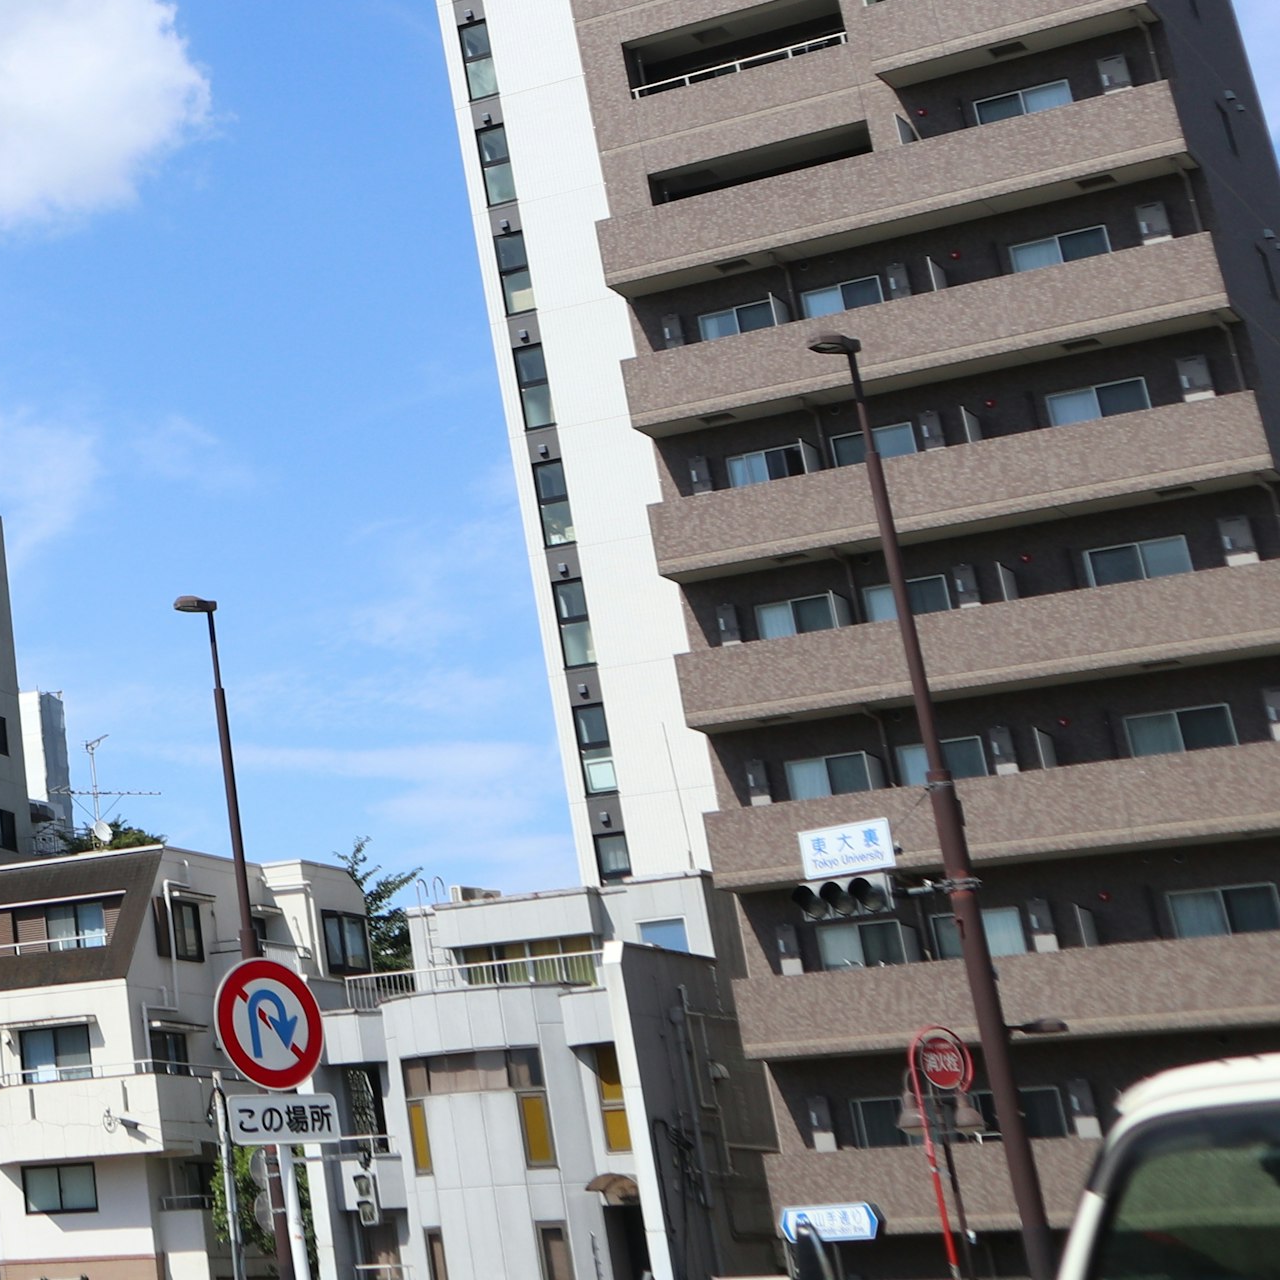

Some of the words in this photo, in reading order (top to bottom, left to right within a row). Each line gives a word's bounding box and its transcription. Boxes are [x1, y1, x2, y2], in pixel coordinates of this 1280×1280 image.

[812, 858, 839, 869] Tokyo
[841, 850, 884, 866] University
[238, 1104, 333, 1133] この場所
